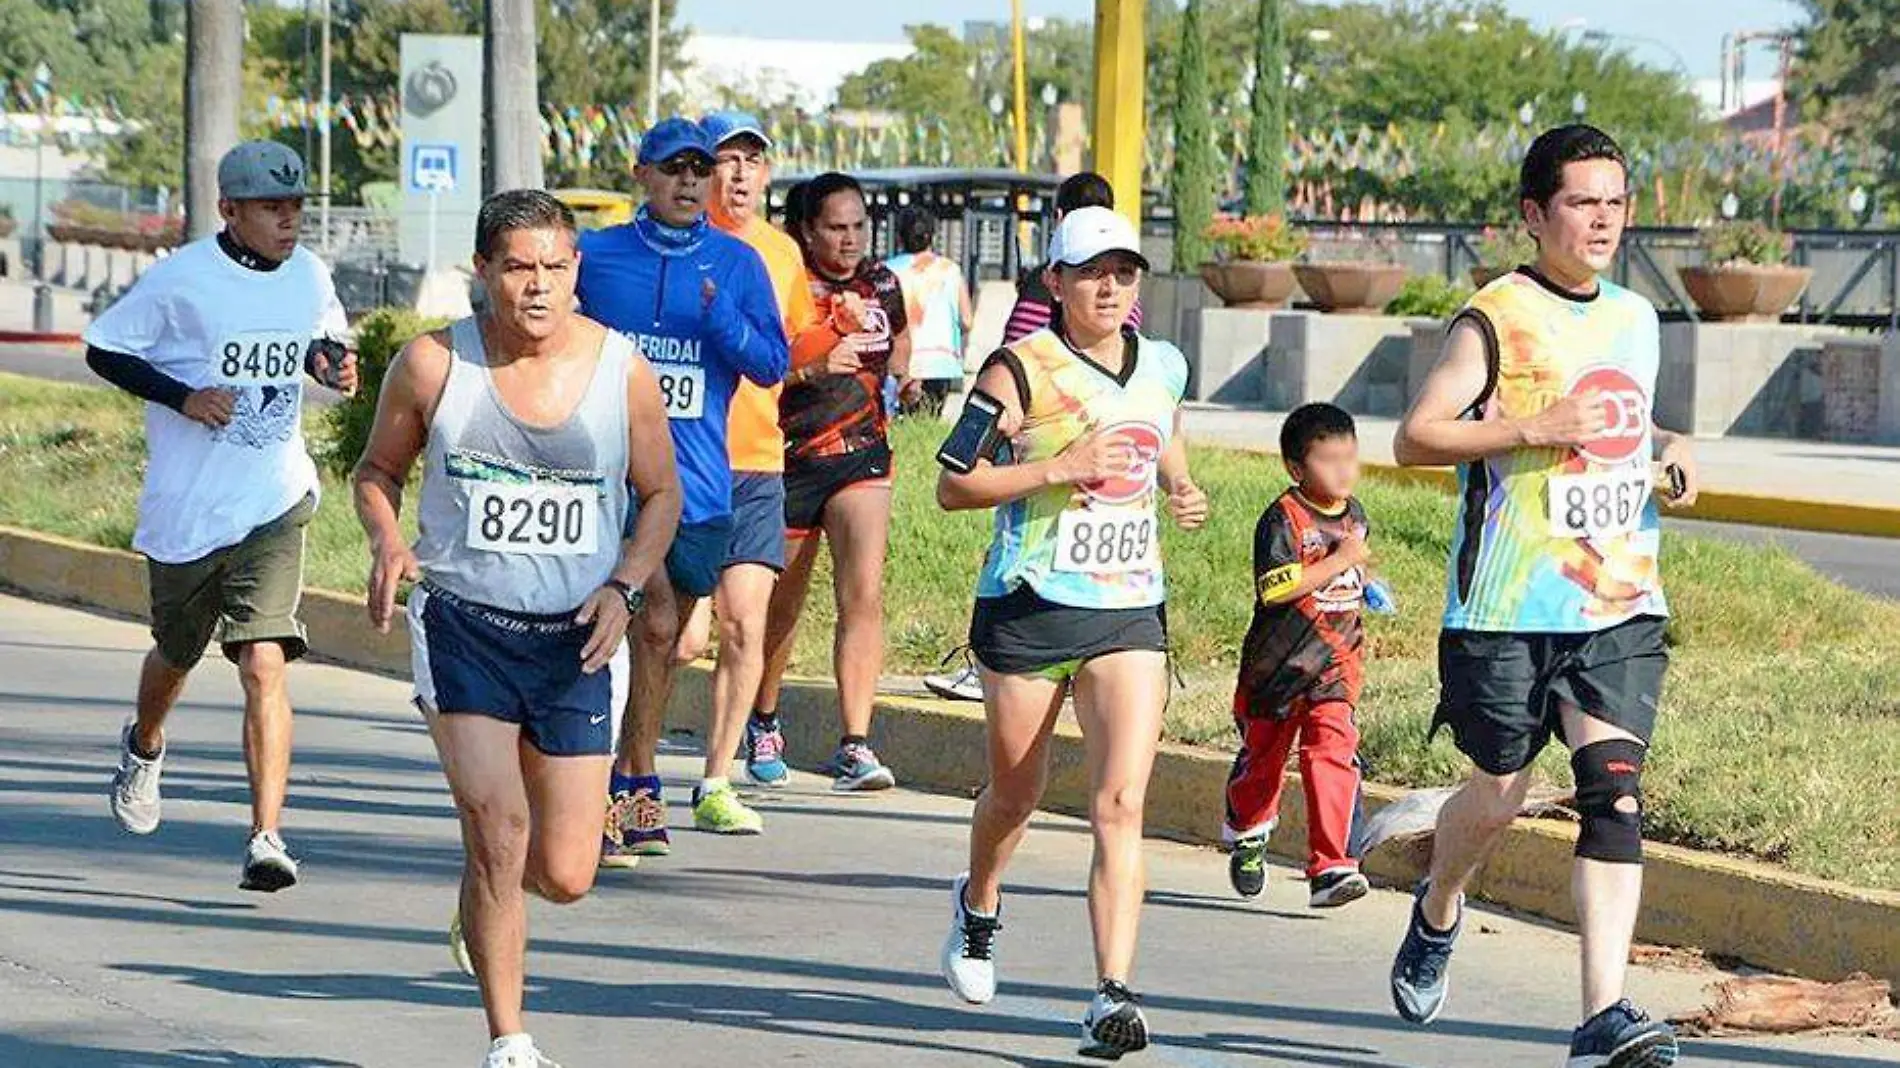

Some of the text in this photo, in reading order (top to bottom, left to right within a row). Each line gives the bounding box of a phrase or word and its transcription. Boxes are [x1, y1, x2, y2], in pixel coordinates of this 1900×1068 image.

[222, 342, 299, 378] 8468
[481, 494, 583, 544] 8290
[1565, 479, 1645, 530] 8867
[1070, 518, 1150, 564] 8869
